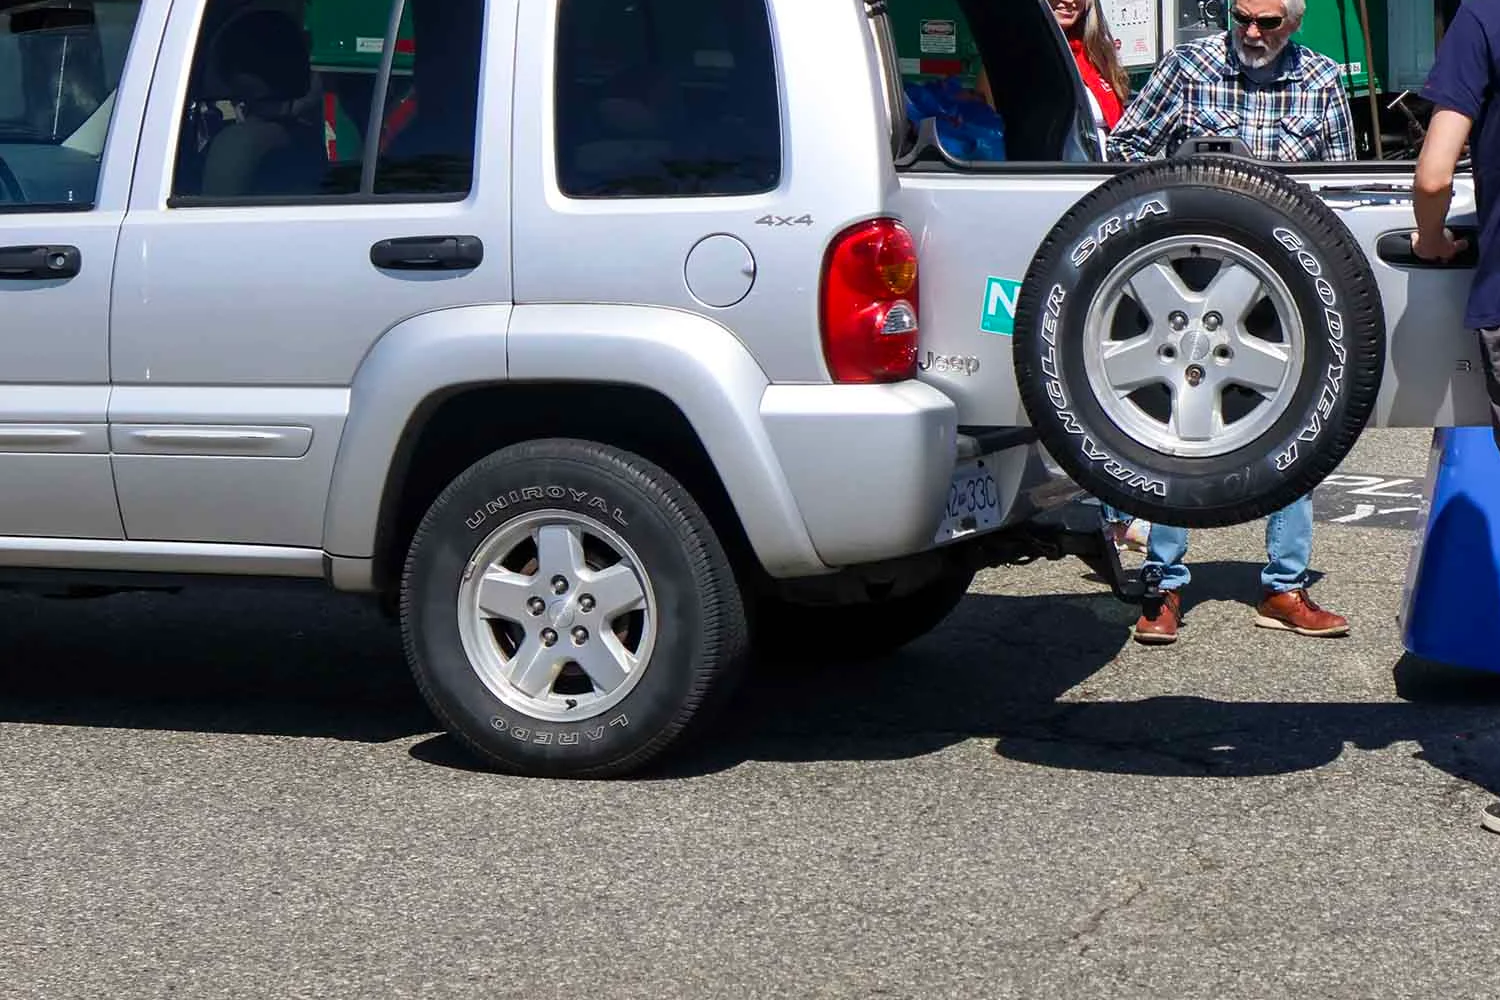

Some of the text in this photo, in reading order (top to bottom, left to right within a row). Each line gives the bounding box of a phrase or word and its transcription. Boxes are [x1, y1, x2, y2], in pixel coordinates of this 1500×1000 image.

[988, 281, 1021, 319] N
[918, 352, 980, 377] Jeep
[1272, 227, 1347, 474] GOODYEAR
[1040, 283, 1167, 497] WRANGLER
[465, 485, 629, 530] UNIROYAL
[490, 712, 630, 745] LAREDO
